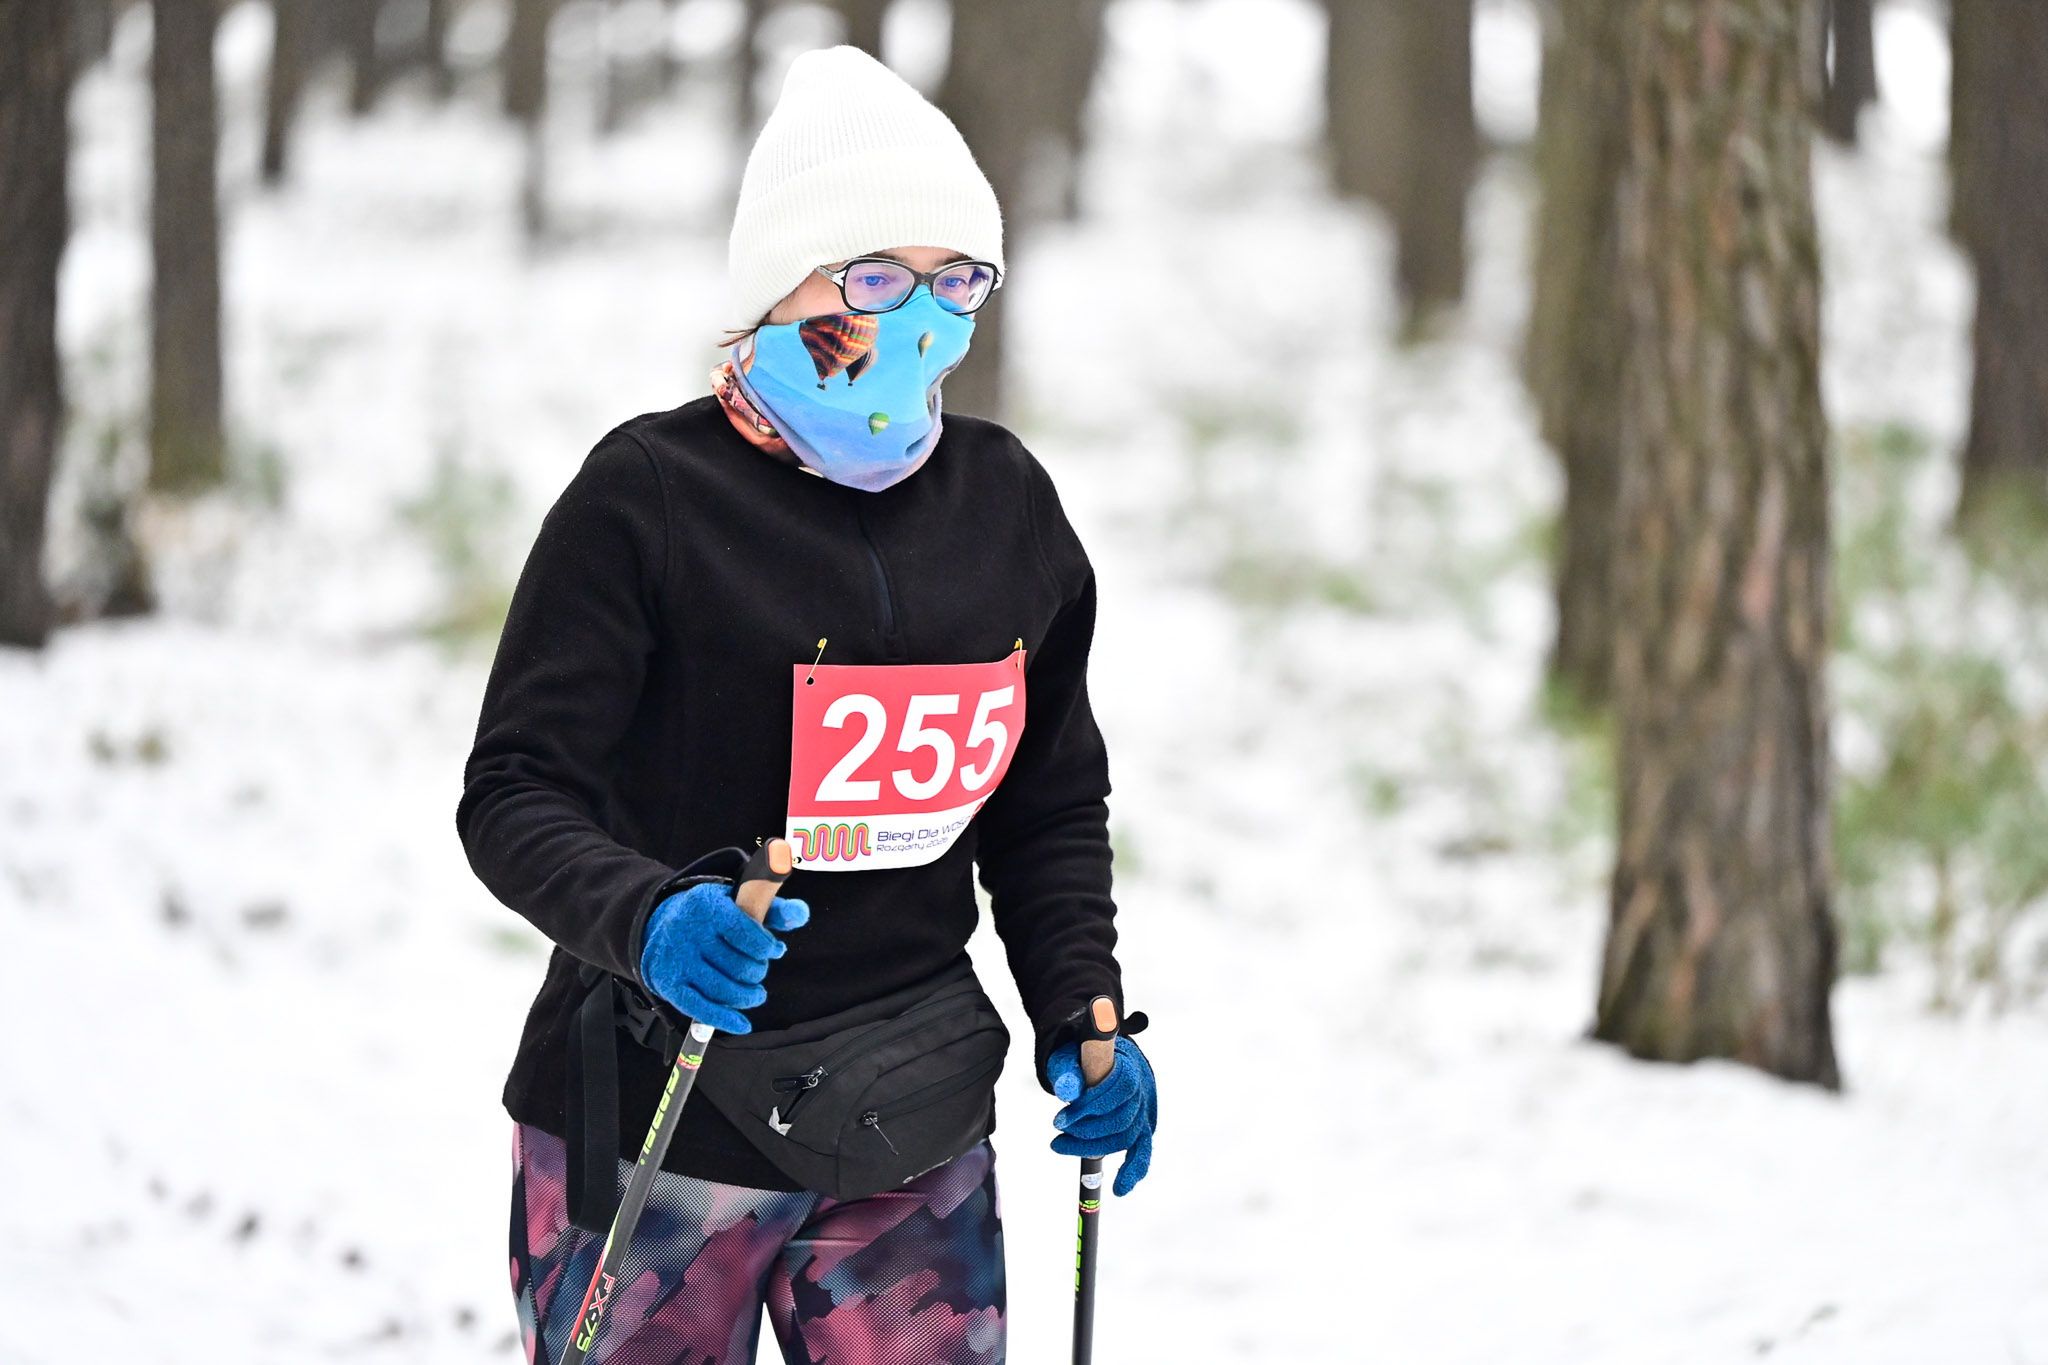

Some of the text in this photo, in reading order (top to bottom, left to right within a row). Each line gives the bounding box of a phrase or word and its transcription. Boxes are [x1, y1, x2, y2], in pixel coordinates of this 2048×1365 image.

[814, 684, 1015, 802] 255
[877, 830, 915, 843] Biegi
[917, 829, 940, 840] Dla
